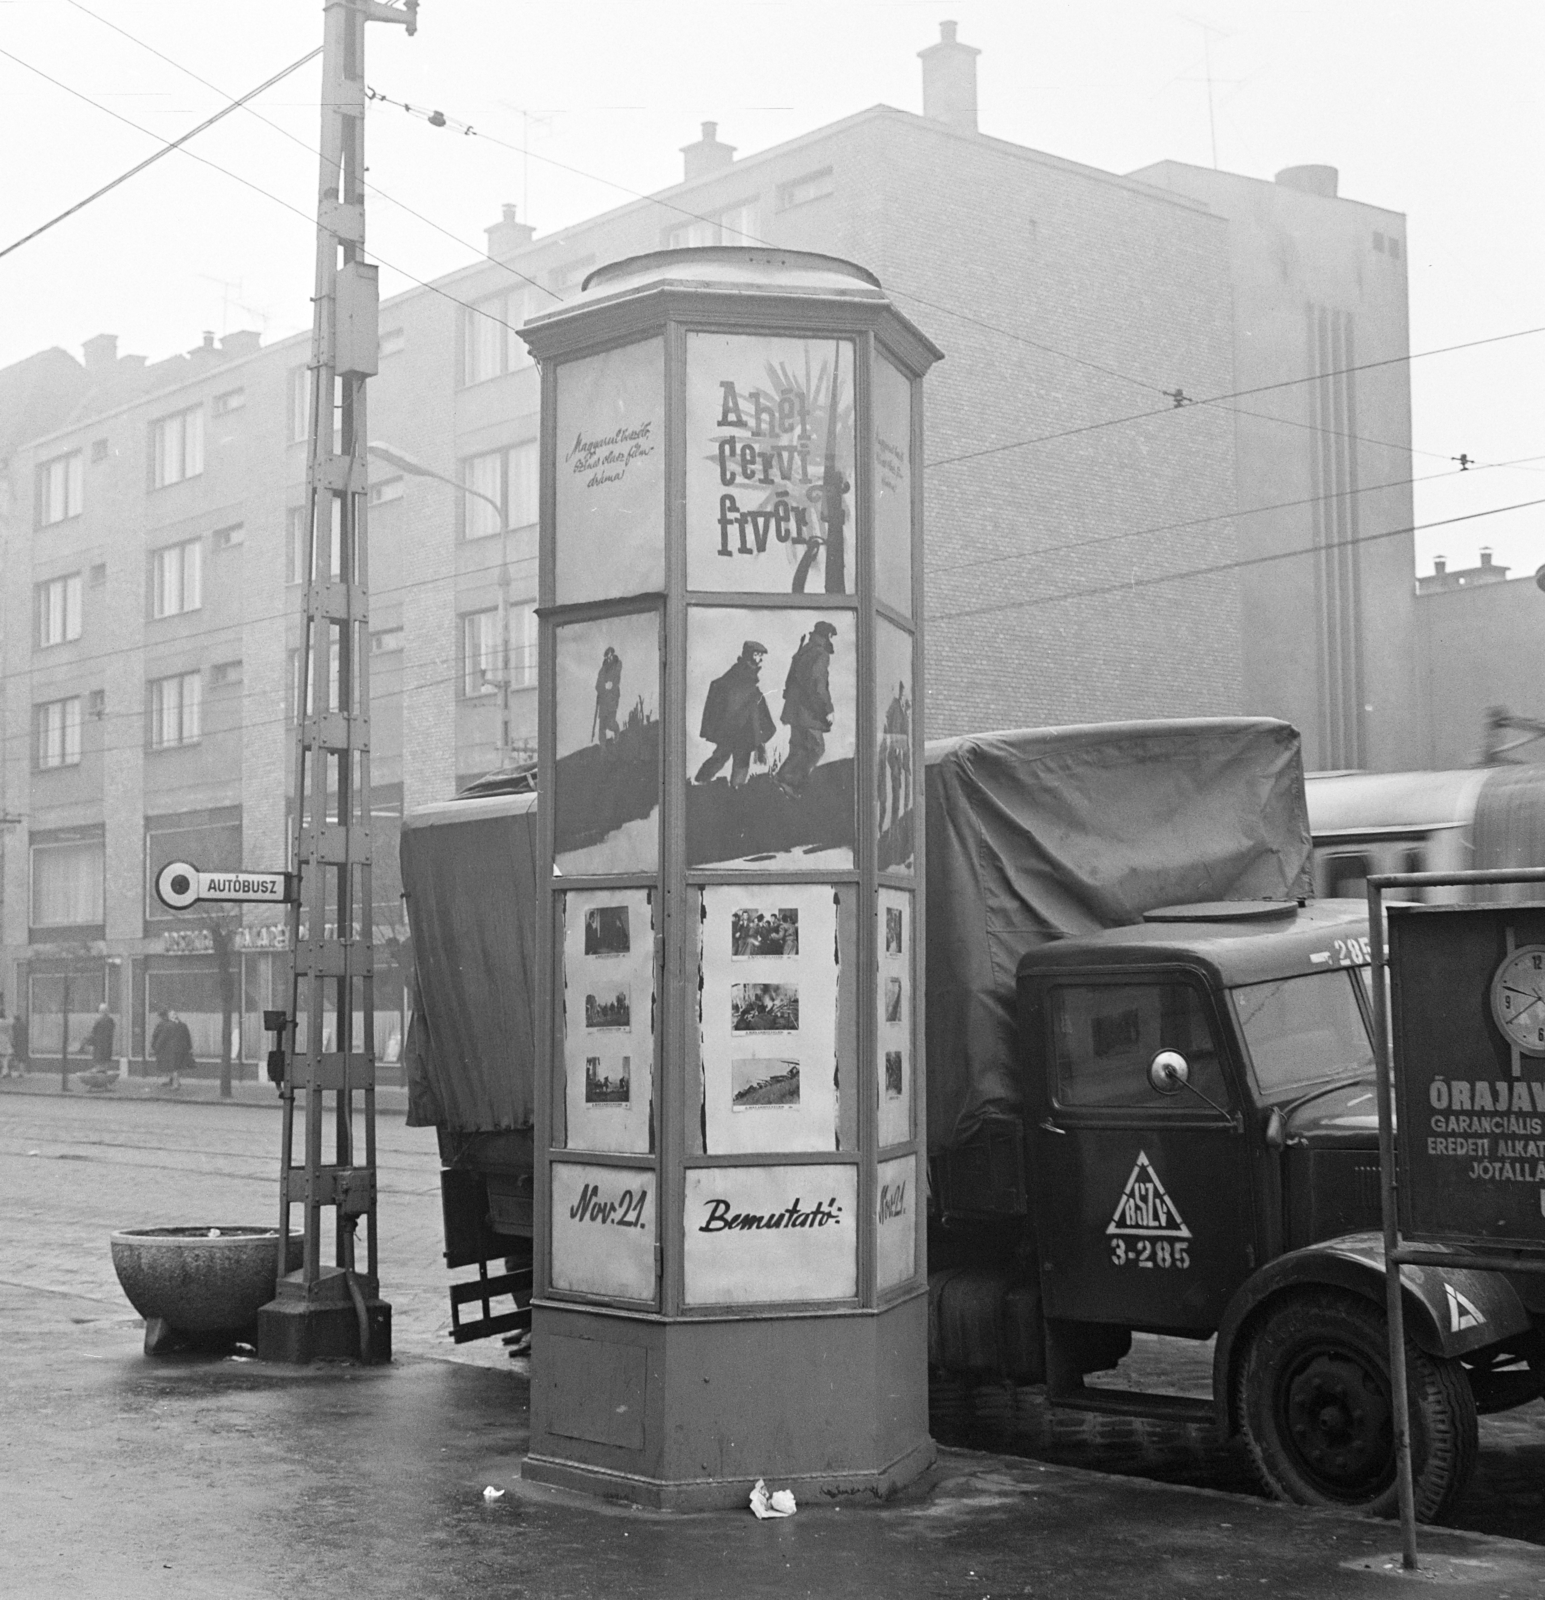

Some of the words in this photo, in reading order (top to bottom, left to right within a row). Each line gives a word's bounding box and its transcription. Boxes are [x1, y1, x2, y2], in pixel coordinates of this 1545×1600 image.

[717, 381, 748, 427] A
[749, 388, 812, 441] hét
[718, 435, 812, 487] Cervi
[207, 874, 278, 894] AUTÓBUSZ
[1532, 955, 1543, 970] 12
[1505, 995, 1511, 1010] 9
[1538, 1027, 1544, 1042] 6
[1430, 1114, 1543, 1135] GARANCIÁLIS
[1427, 1137, 1489, 1156] EREDETI
[698, 1197, 843, 1232] Bemutató:
[1110, 1238, 1191, 1269] 3-285
